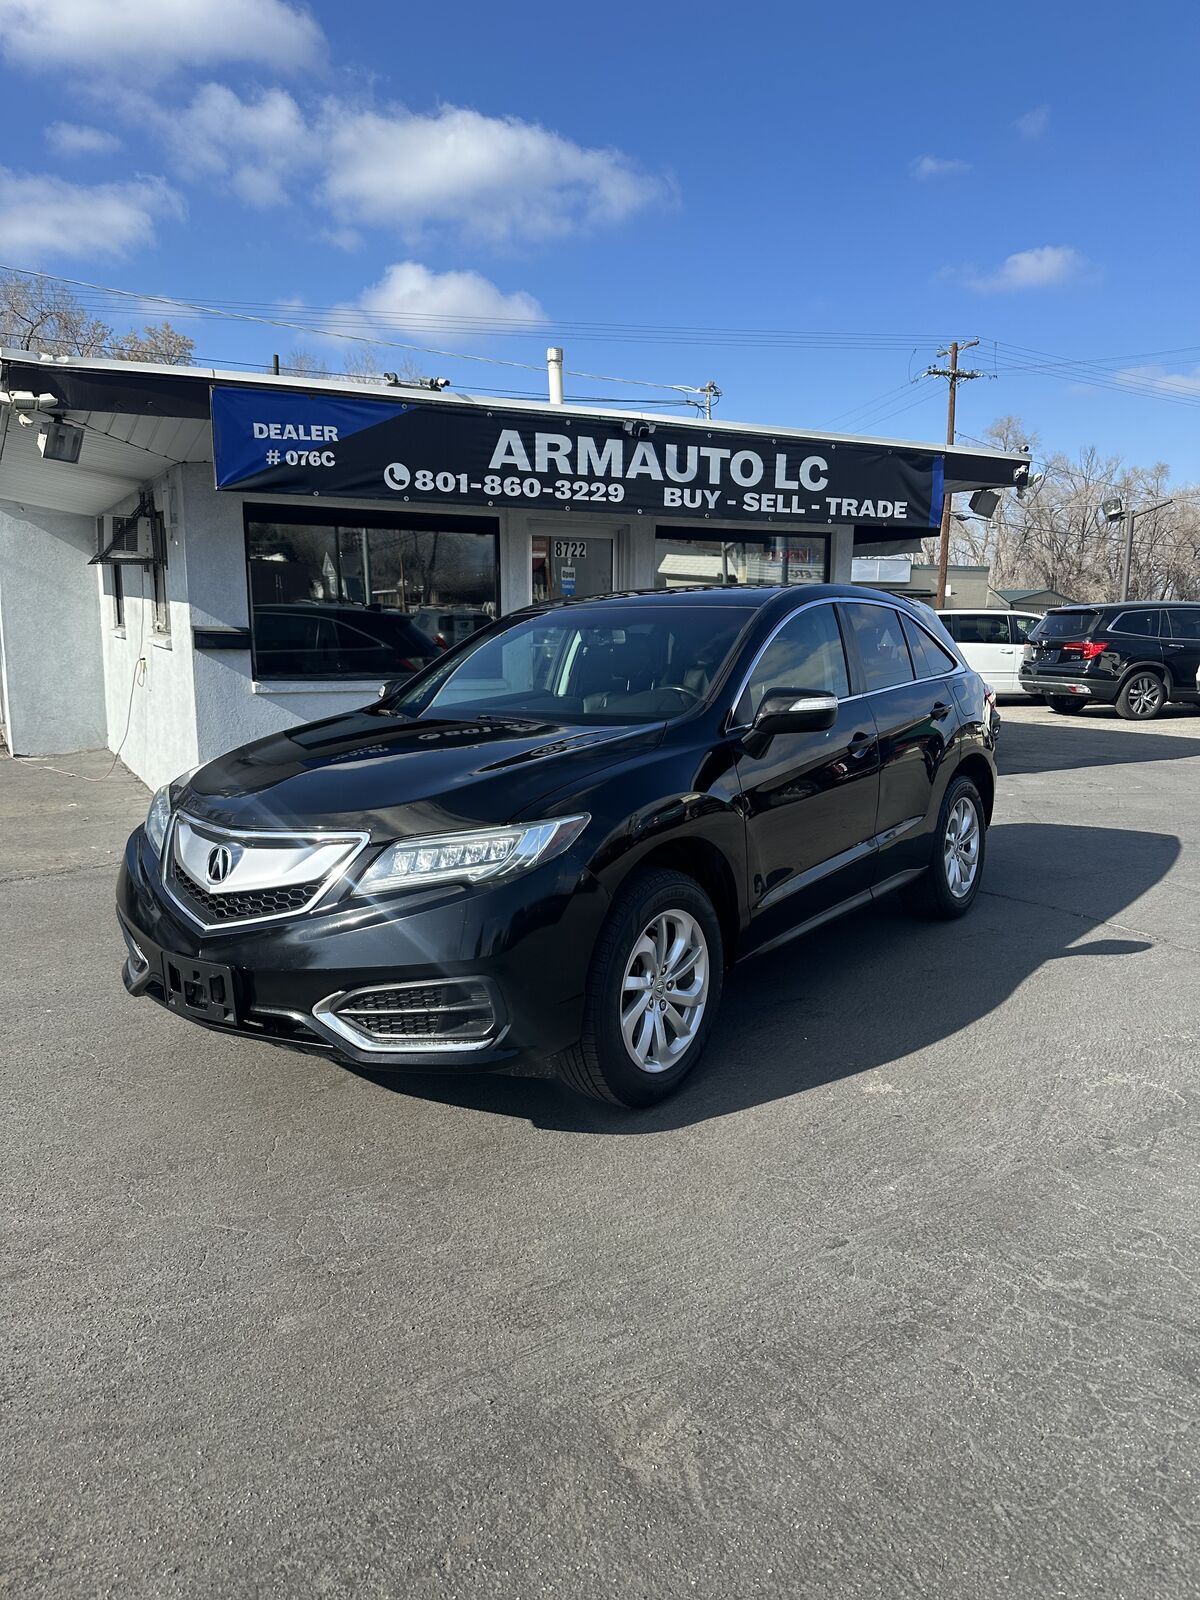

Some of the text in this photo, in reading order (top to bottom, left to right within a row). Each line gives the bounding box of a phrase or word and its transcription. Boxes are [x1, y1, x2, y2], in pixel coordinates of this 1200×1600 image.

[253, 423, 338, 441] DEALER
[266, 450, 336, 467] # 076C
[488, 429, 829, 491] ARMAUTO LC
[414, 470, 625, 502] 801-860-3229
[663, 488, 722, 509] BUY
[743, 493, 806, 514] SELL
[826, 497, 908, 518] TRADE
[555, 541, 586, 558] 8722
